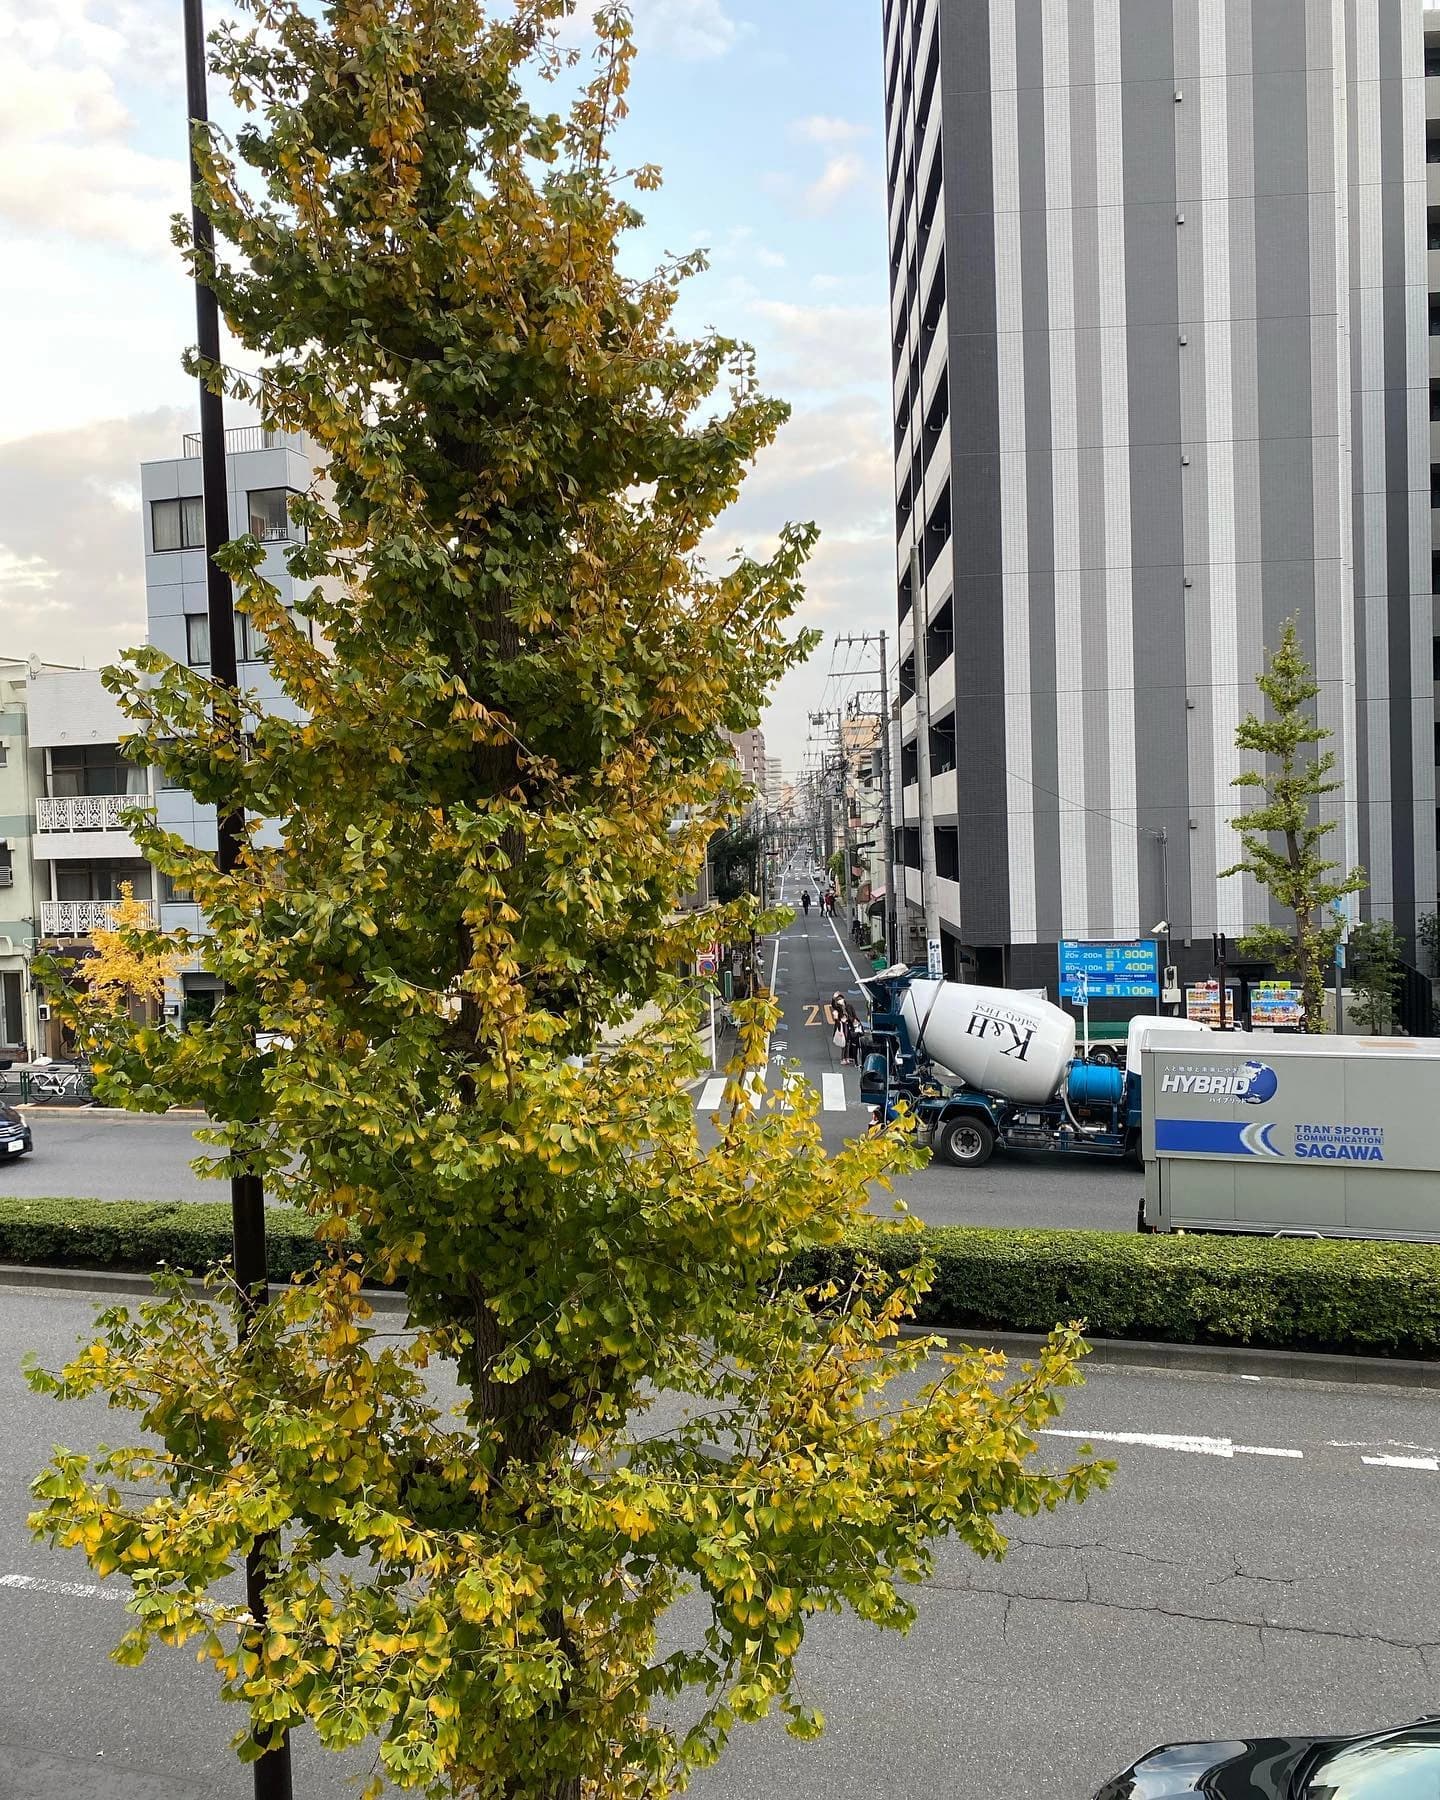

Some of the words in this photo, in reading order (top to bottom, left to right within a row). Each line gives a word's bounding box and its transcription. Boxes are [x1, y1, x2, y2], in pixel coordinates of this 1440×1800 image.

[975, 1004, 1000, 1018] First
[1003, 1011, 1038, 1031] Safety
[1161, 1074, 1250, 1095] HYBRID
[1296, 1134, 1382, 1144] COMMUNICATION
[1294, 1143, 1384, 1161] SAGAWA
